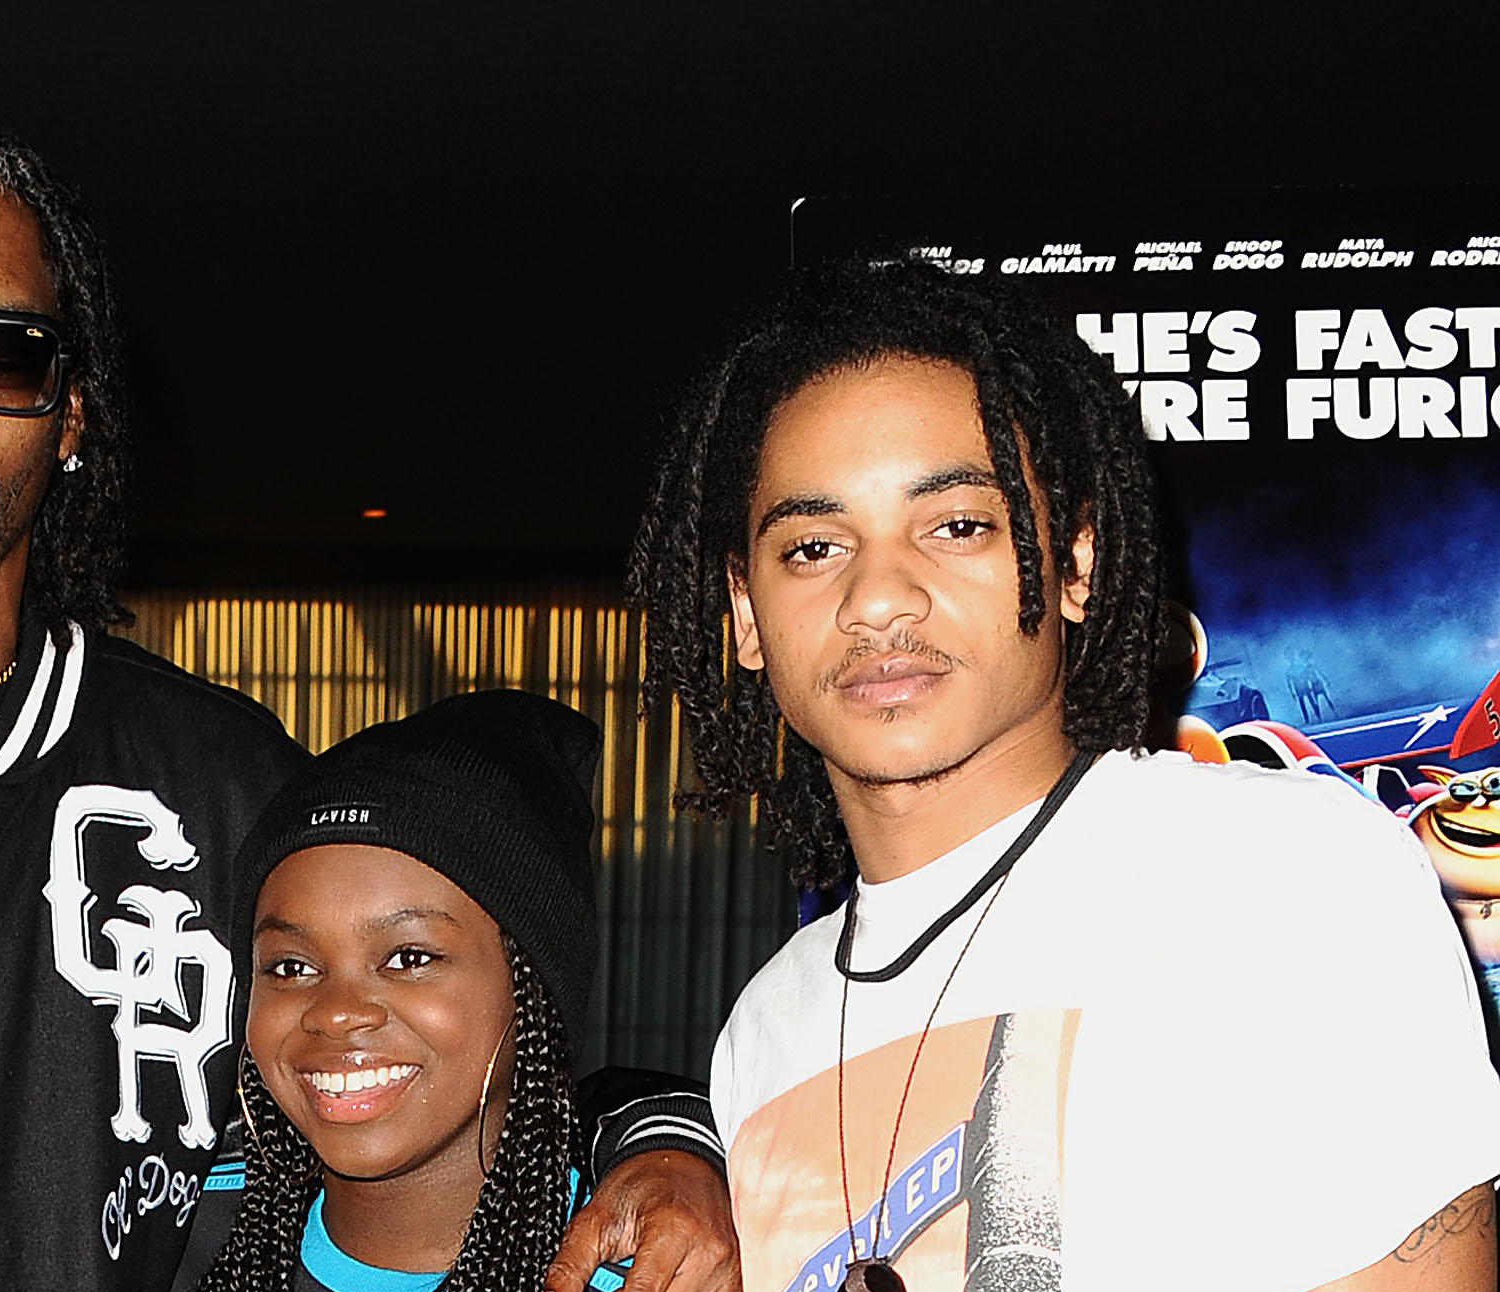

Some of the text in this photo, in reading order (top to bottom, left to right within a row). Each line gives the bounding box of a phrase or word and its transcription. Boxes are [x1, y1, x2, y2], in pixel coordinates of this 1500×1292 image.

[1042, 243, 1082, 256] PAUL
[1134, 241, 1203, 255] MICHAEL
[1225, 240, 1283, 252] SNOOP
[1338, 238, 1385, 250] MAYA
[1000, 256, 1116, 274] GIAMATTI
[1133, 253, 1194, 271] PEÑA
[1213, 253, 1284, 270] DOGG
[1301, 250, 1414, 269] RUDOLPH
[1430, 250, 1500, 267] RODR
[1075, 307, 1500, 374] HE'S FAST
[1121, 376, 1500, 441] 'RE FURI
[311, 809, 370, 825] LAVISH
[906, 1147, 956, 1215] EP
[137, 1152, 201, 1228] Dog
